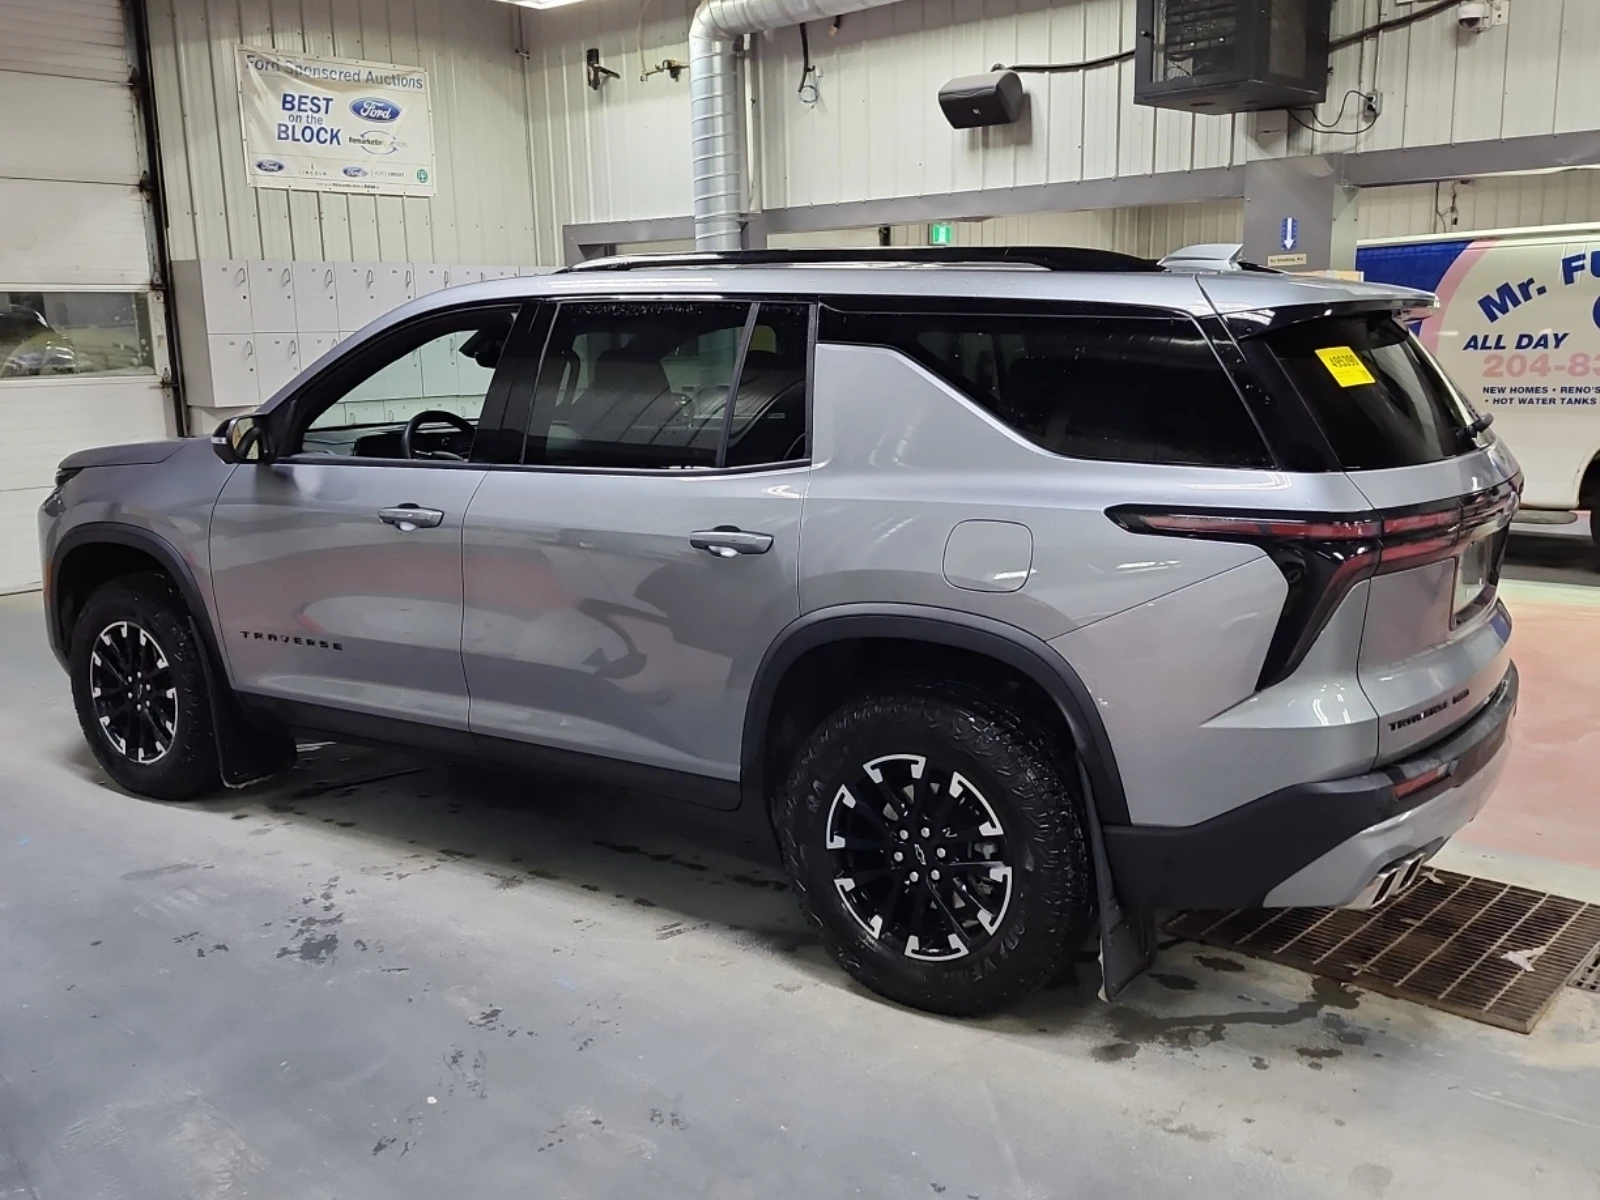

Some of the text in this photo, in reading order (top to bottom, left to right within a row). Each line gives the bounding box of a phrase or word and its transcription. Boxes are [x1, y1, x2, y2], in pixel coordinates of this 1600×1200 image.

[365, 71, 423, 89] Auctions
[281, 93, 334, 115] BEST
[288, 114, 324, 125] on the
[277, 123, 342, 146] BLOCK
[1477, 277, 1547, 323] Mr.
[1463, 332, 1569, 351] ALL DAY
[1482, 386, 1600, 395] NEW HOMES RENO'S
[1492, 397, 1597, 405] HOT WATER TANKS
[240, 630, 343, 651] TRAVERSE
